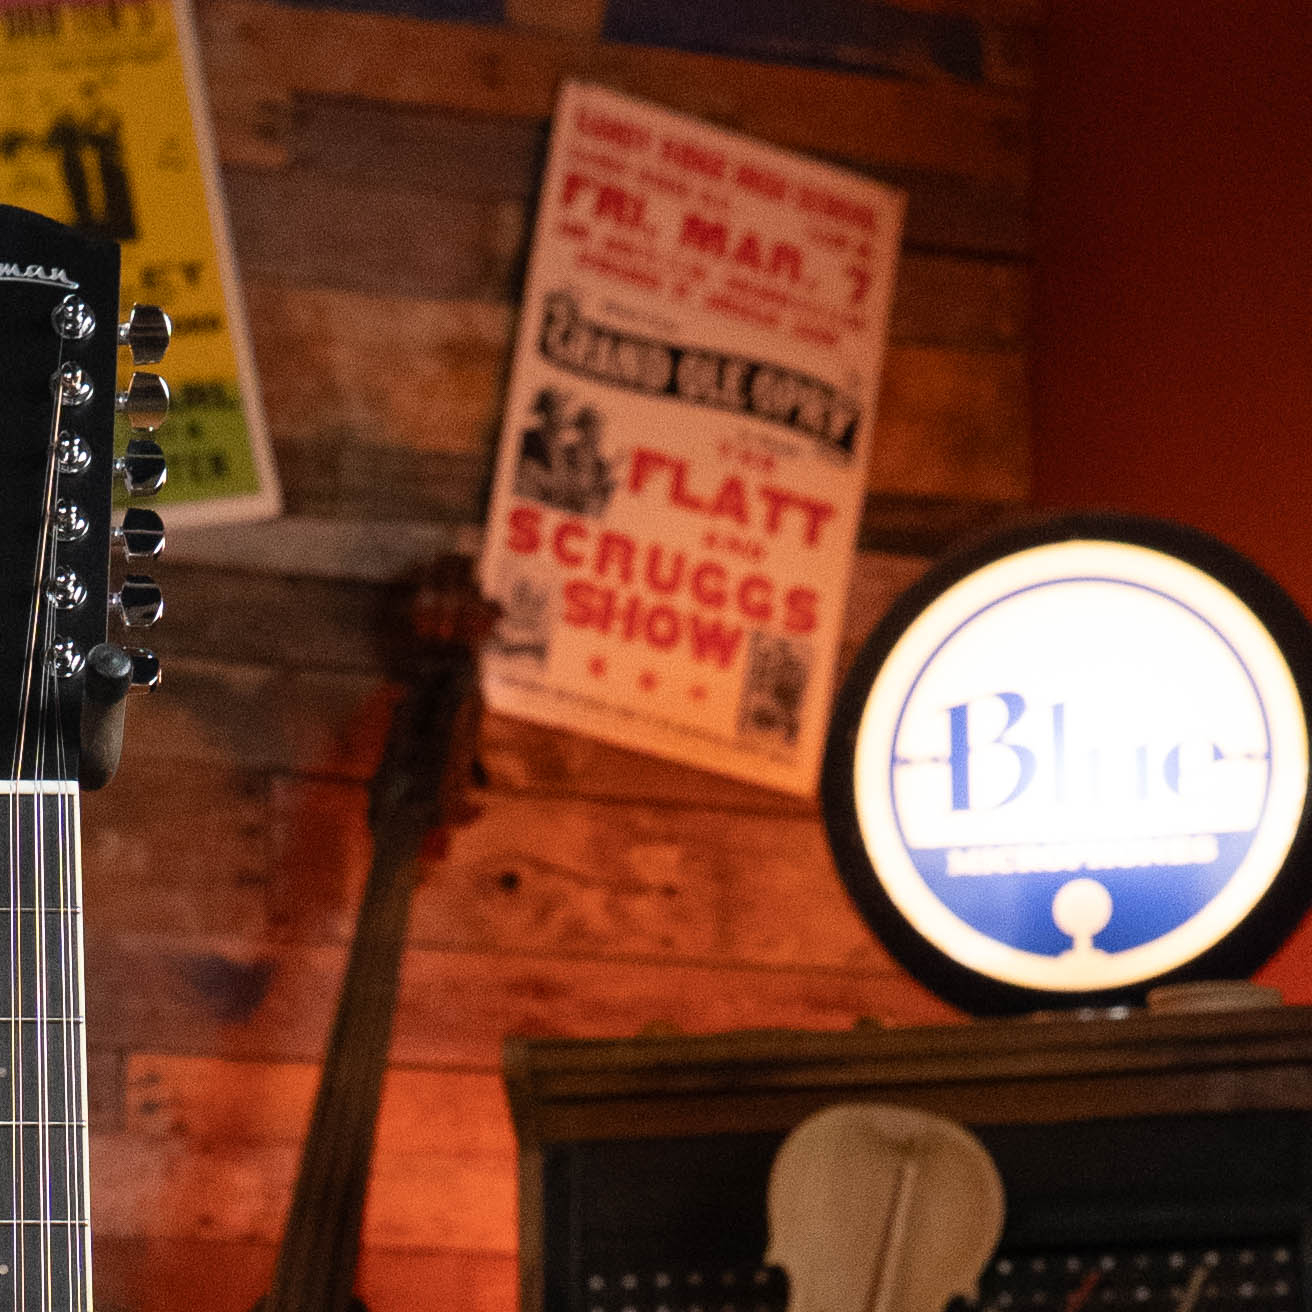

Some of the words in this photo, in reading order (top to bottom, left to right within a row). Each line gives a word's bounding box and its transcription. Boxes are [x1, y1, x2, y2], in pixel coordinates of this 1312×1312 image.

[628, 445, 836, 550] FLATT
[506, 507, 820, 636] SCRUGGS
[562, 580, 742, 672] SHOW
